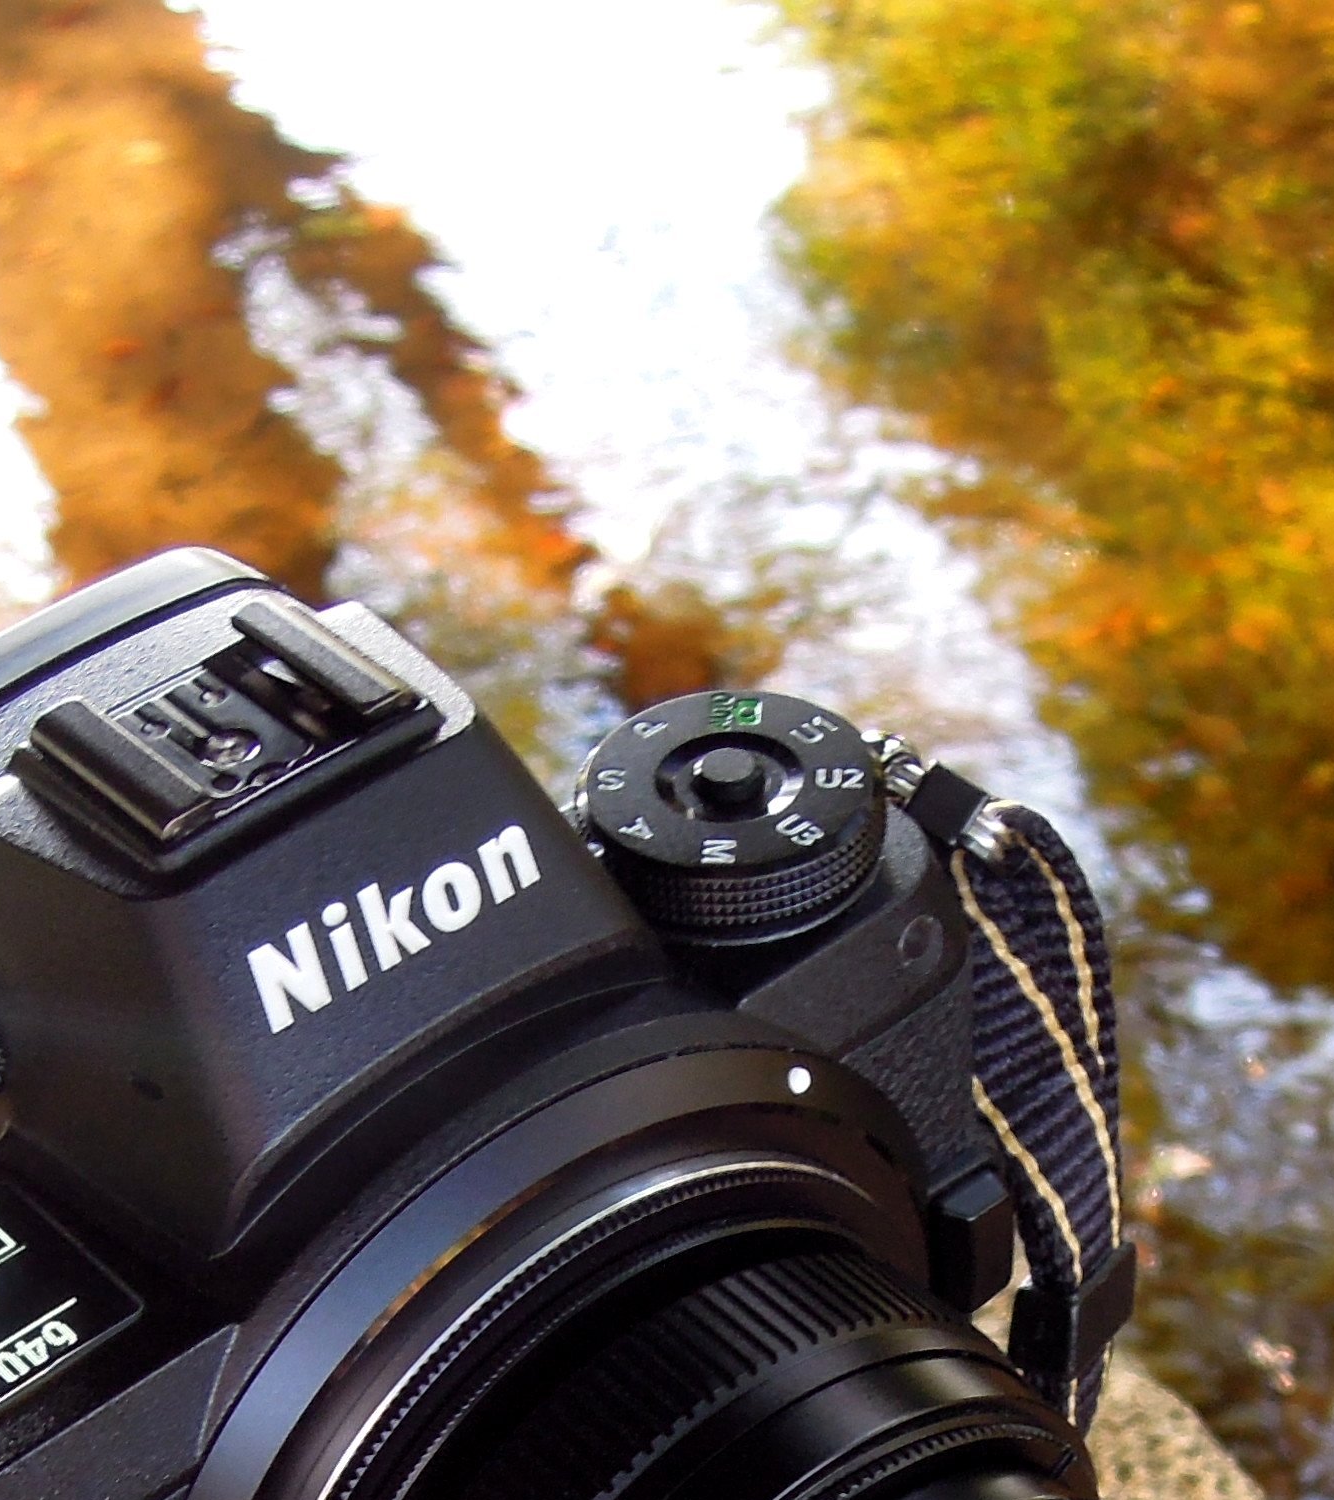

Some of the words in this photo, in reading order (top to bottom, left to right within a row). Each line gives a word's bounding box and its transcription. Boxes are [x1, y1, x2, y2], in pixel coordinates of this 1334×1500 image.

[633, 719, 668, 739] P
[789, 715, 840, 745] U1
[597, 768, 627, 792] S
[814, 767, 865, 790] U2
[617, 815, 655, 842] A
[775, 812, 827, 847] U3
[700, 838, 737, 863] M
[246, 824, 542, 1035] Nikon
